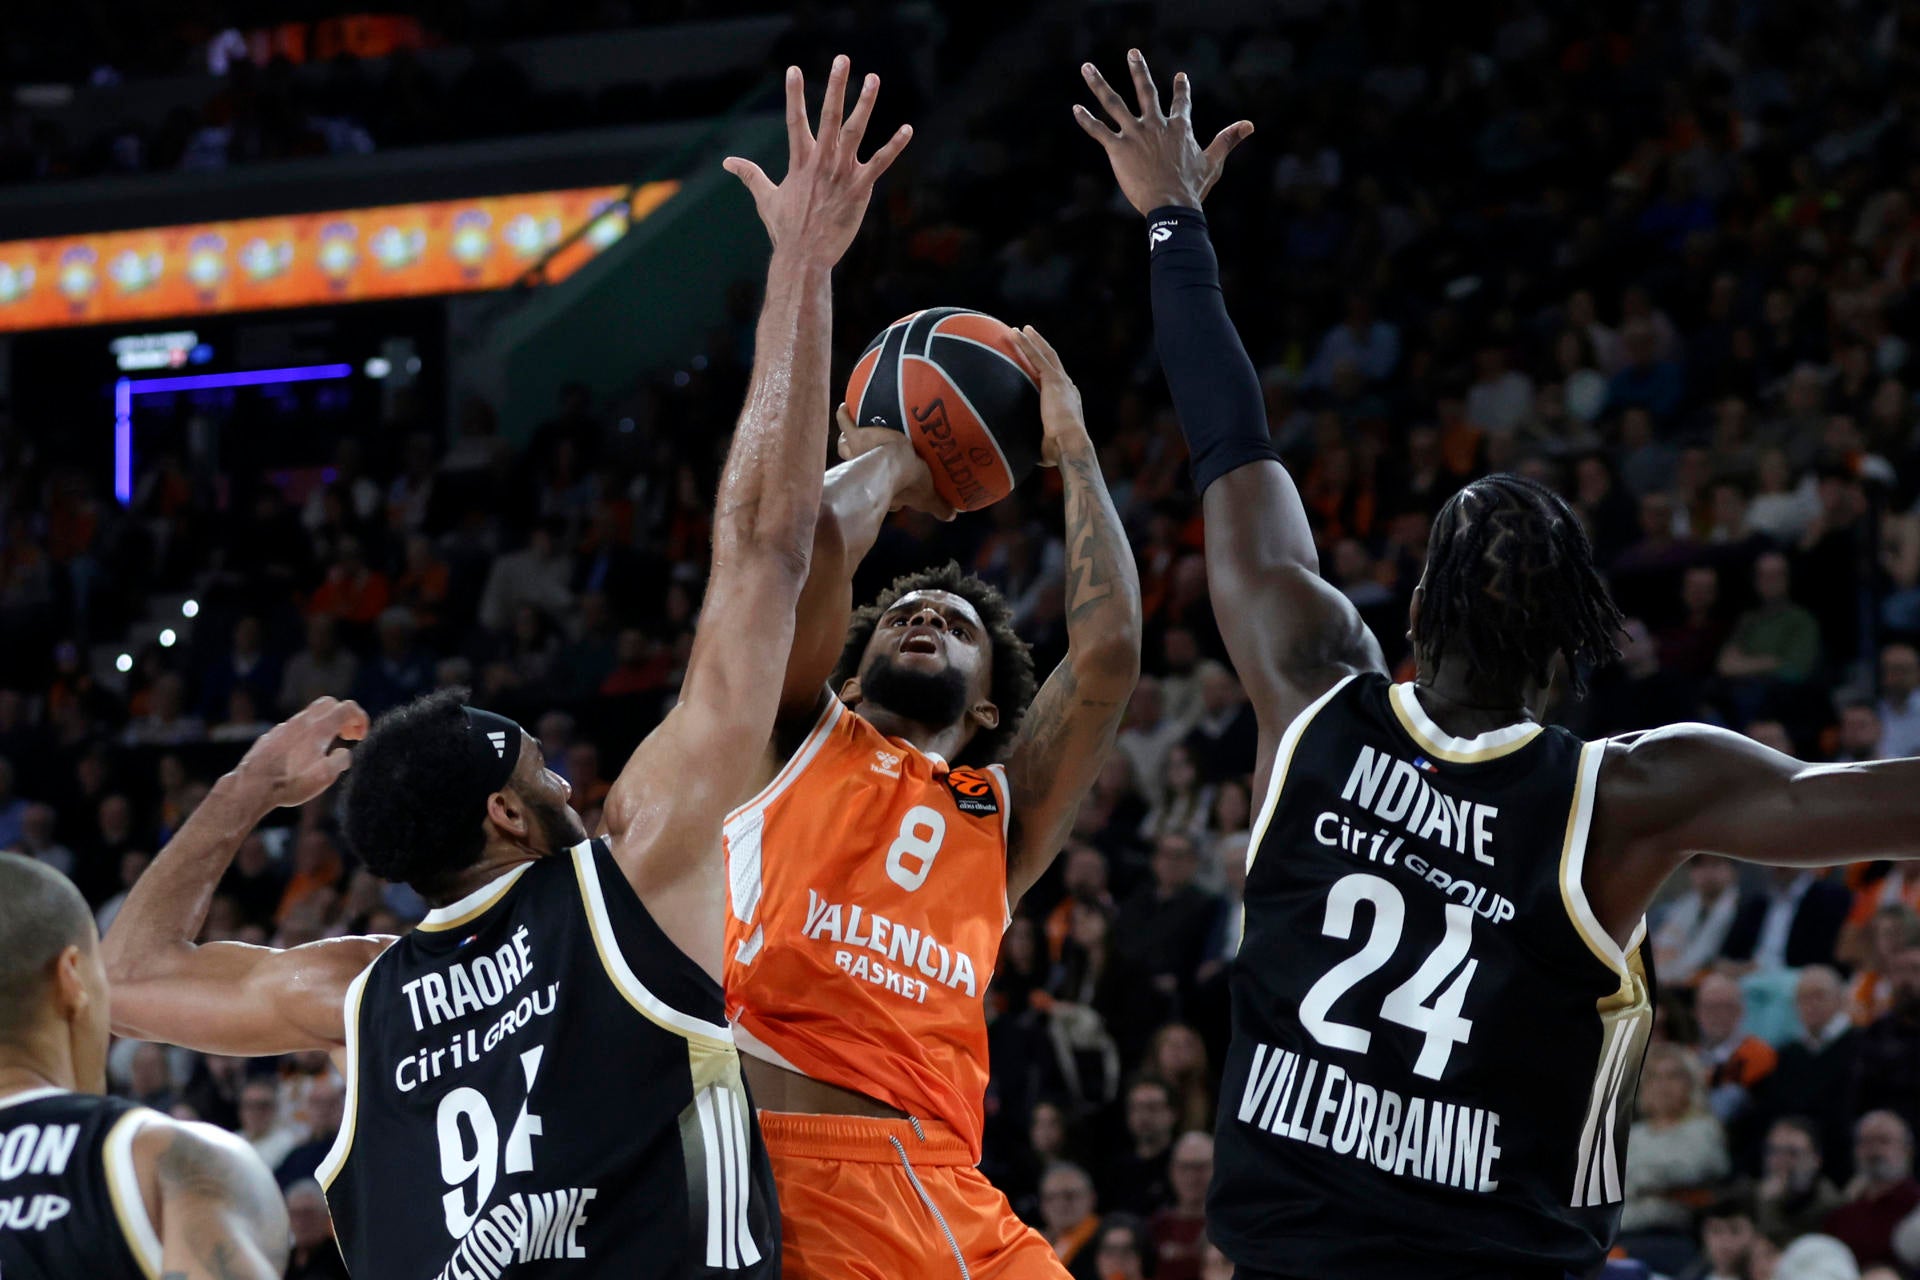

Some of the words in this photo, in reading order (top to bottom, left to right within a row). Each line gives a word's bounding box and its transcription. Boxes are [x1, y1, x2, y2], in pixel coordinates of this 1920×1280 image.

[911, 397, 993, 506] SPALDIN
[885, 805, 946, 892] 8
[1341, 745, 1499, 867] NDIAYE
[402, 924, 534, 1032] TRAORÉ
[801, 888, 976, 998] VALENCIA
[834, 950, 929, 1004] BASKET
[1299, 873, 1479, 1081] 24
[483, 981, 560, 1052] GROU
[0, 1123, 81, 1181] ON
[1237, 1043, 1501, 1192] VILLEURBANNE
